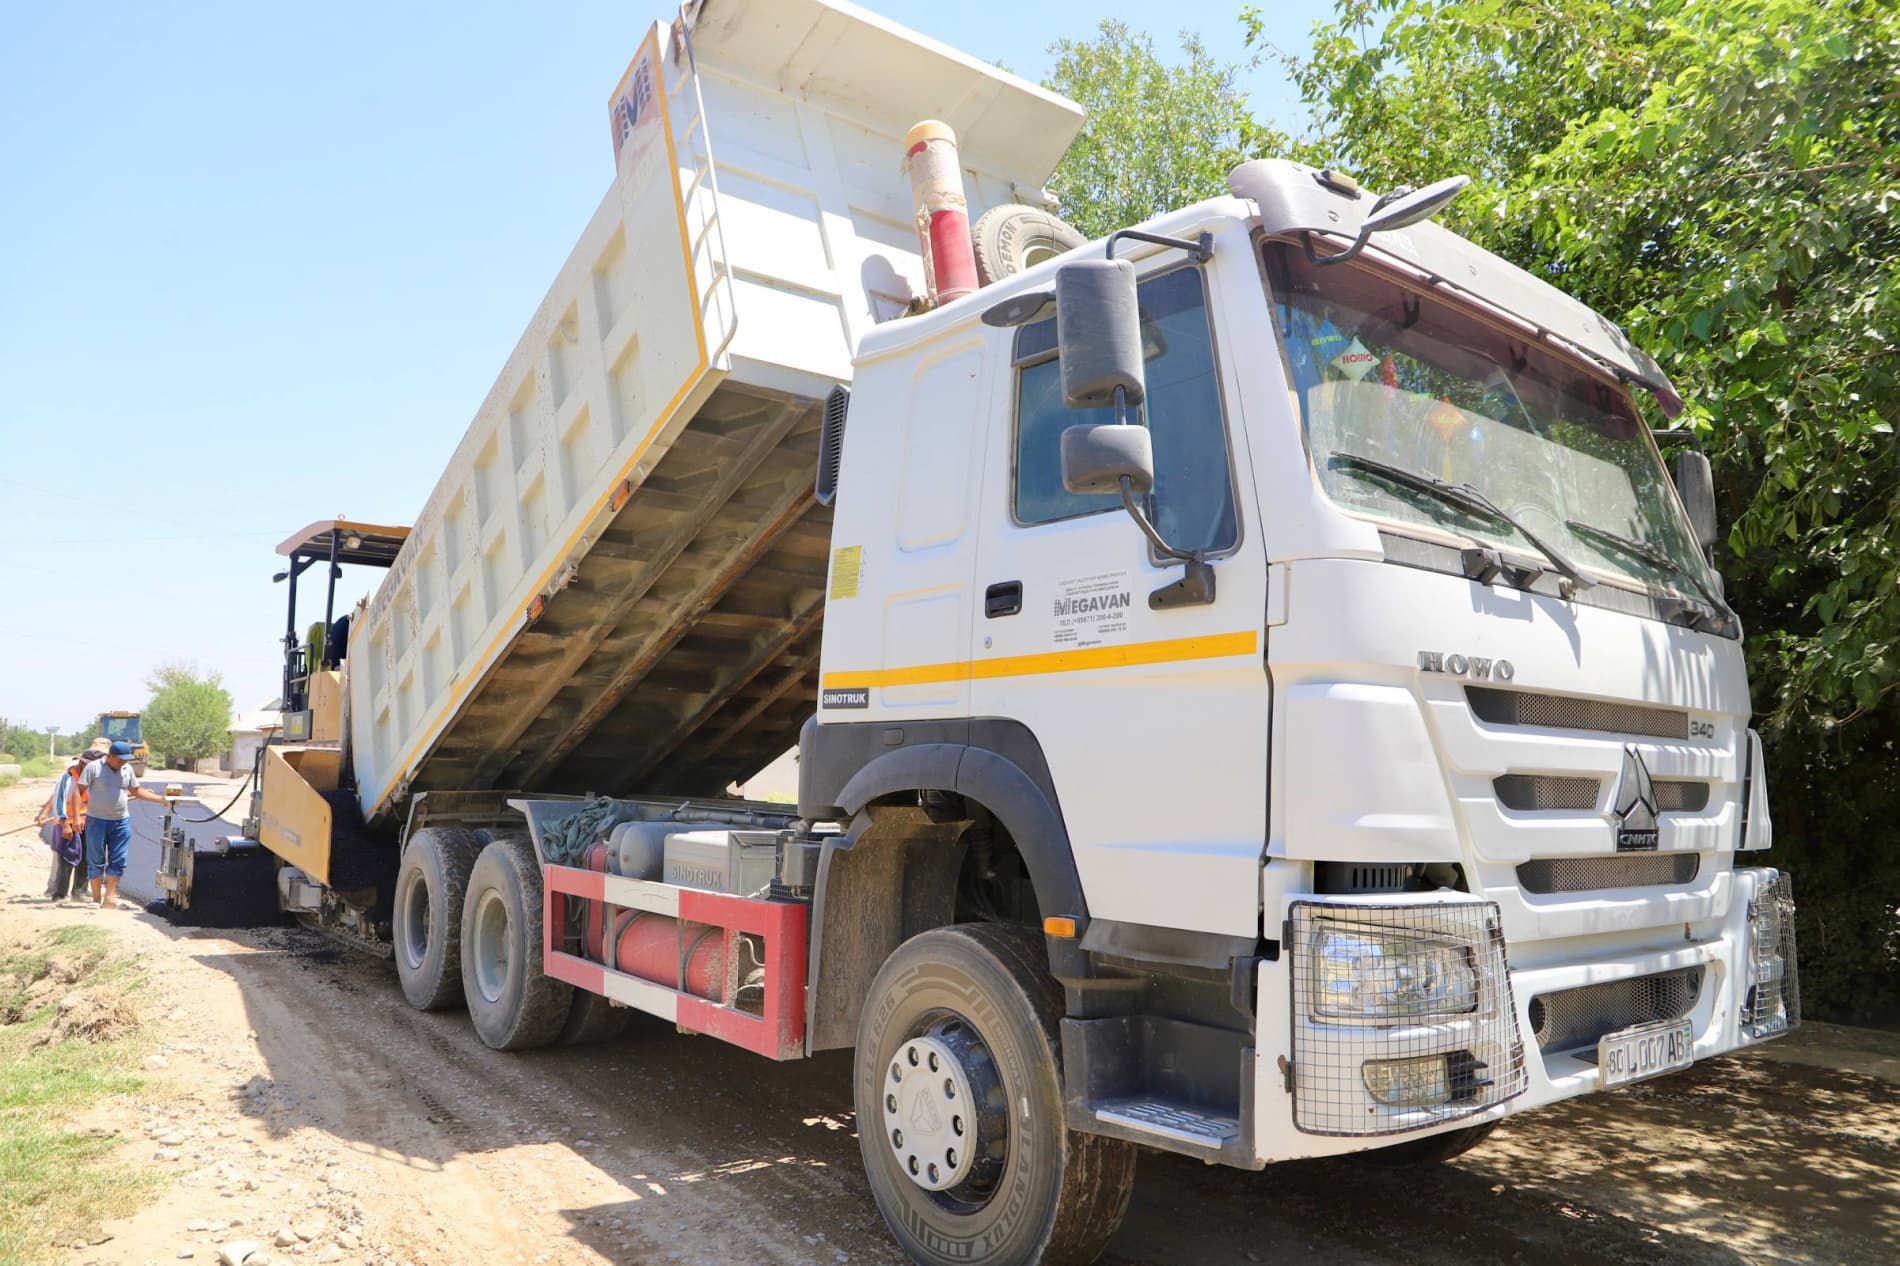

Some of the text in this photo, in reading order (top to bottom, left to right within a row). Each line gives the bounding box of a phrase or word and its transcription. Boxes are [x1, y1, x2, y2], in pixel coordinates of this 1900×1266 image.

[1054, 592, 1130, 616] MEGAVAN
[1417, 650, 1515, 681] HOWO
[823, 692, 866, 705] SINOTRUK
[1690, 721, 1714, 739] 340
[672, 863, 722, 887] SINOTRUK
